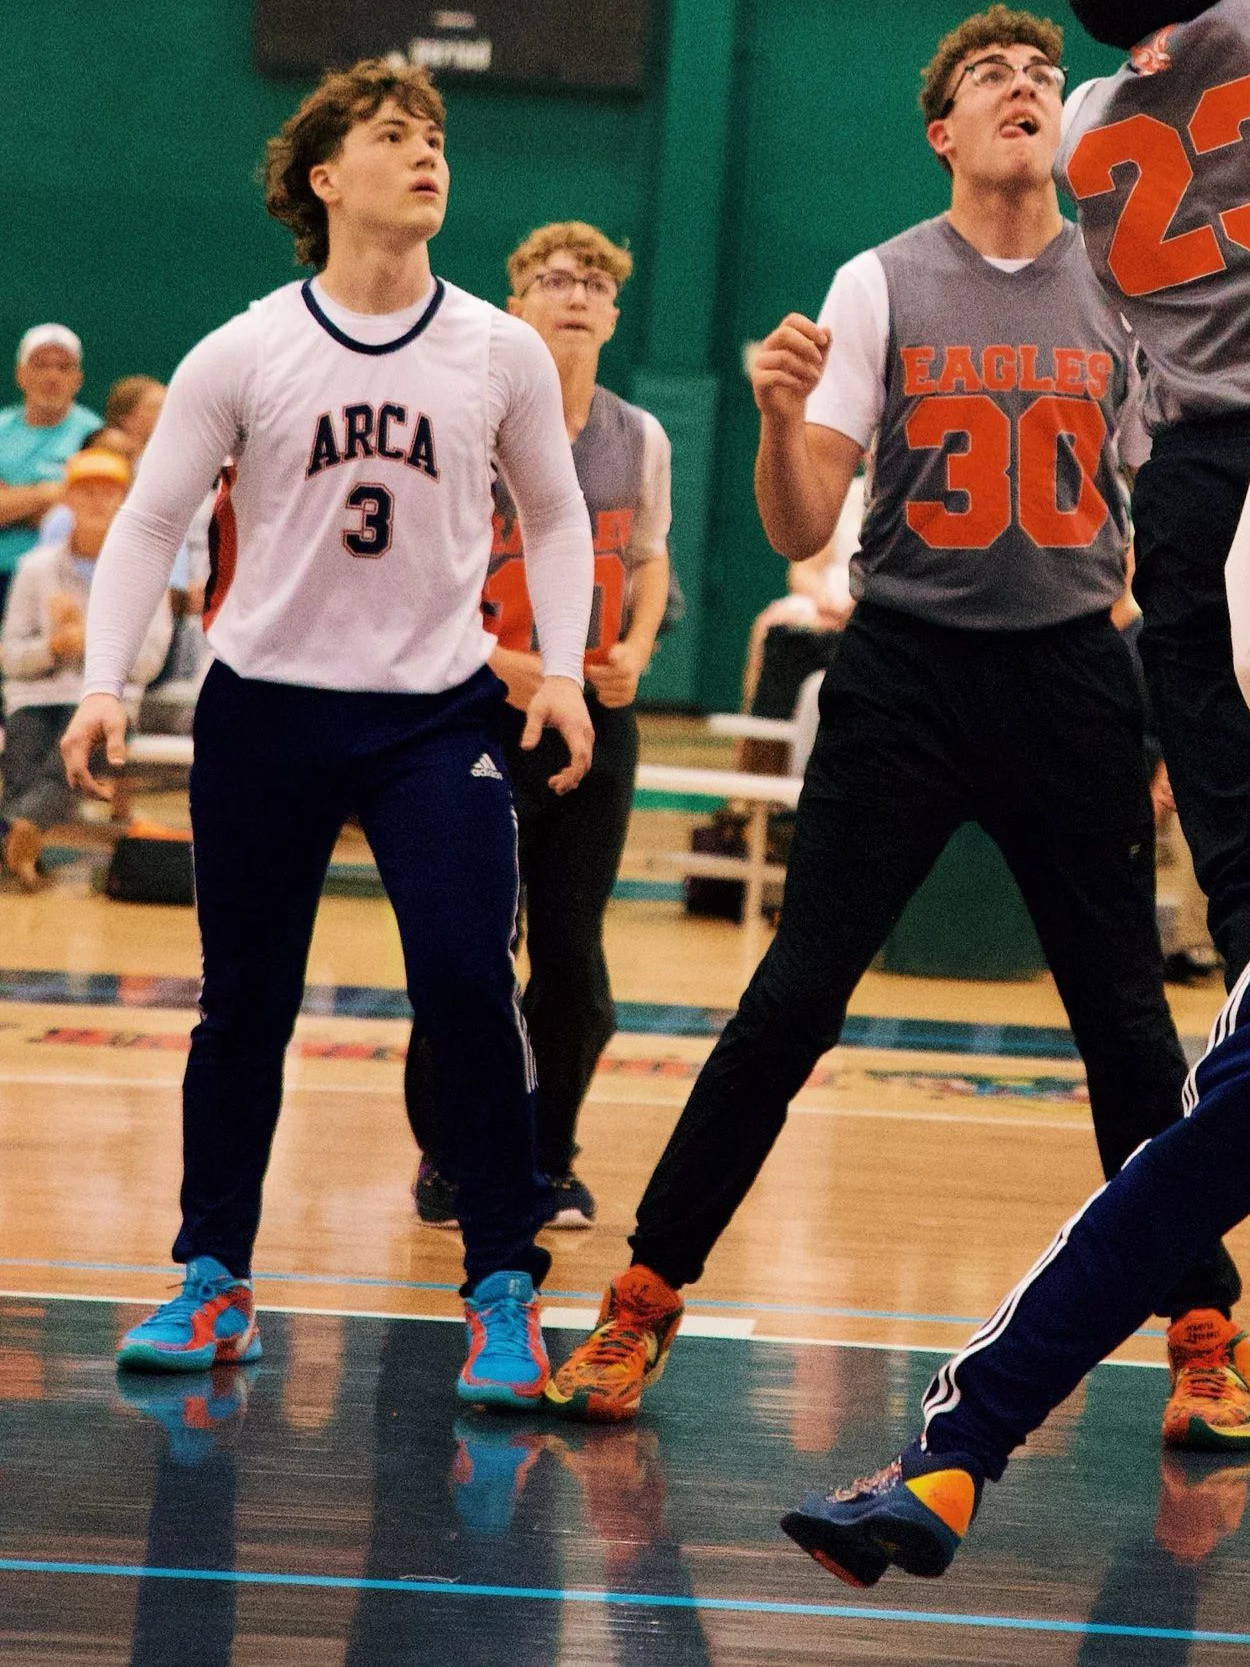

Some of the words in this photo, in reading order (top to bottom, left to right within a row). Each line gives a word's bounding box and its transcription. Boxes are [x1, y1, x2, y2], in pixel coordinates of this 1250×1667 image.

[900, 344, 1113, 397] EAGLES
[305, 400, 440, 483] ARCA
[906, 395, 1109, 549] 30
[342, 482, 395, 559] 3
